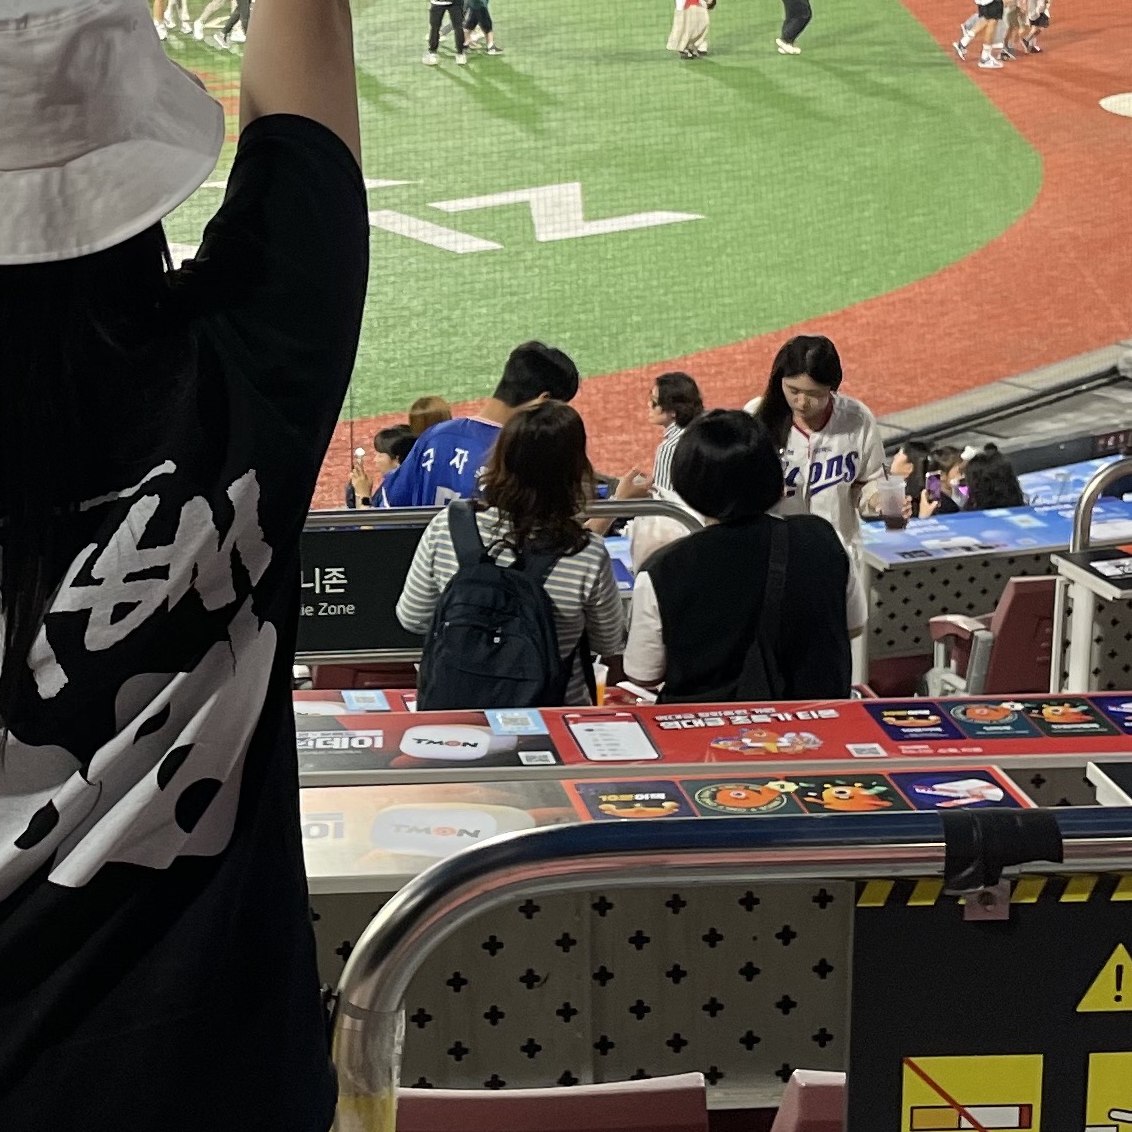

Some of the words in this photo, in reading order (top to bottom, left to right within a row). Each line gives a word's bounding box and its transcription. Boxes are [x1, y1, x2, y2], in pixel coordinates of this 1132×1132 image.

[300, 567, 348, 594] 니존
[300, 604, 315, 617] ie
[318, 602, 356, 616] Zone
[412, 737, 479, 749] TMON
[391, 824, 481, 839] TMON
